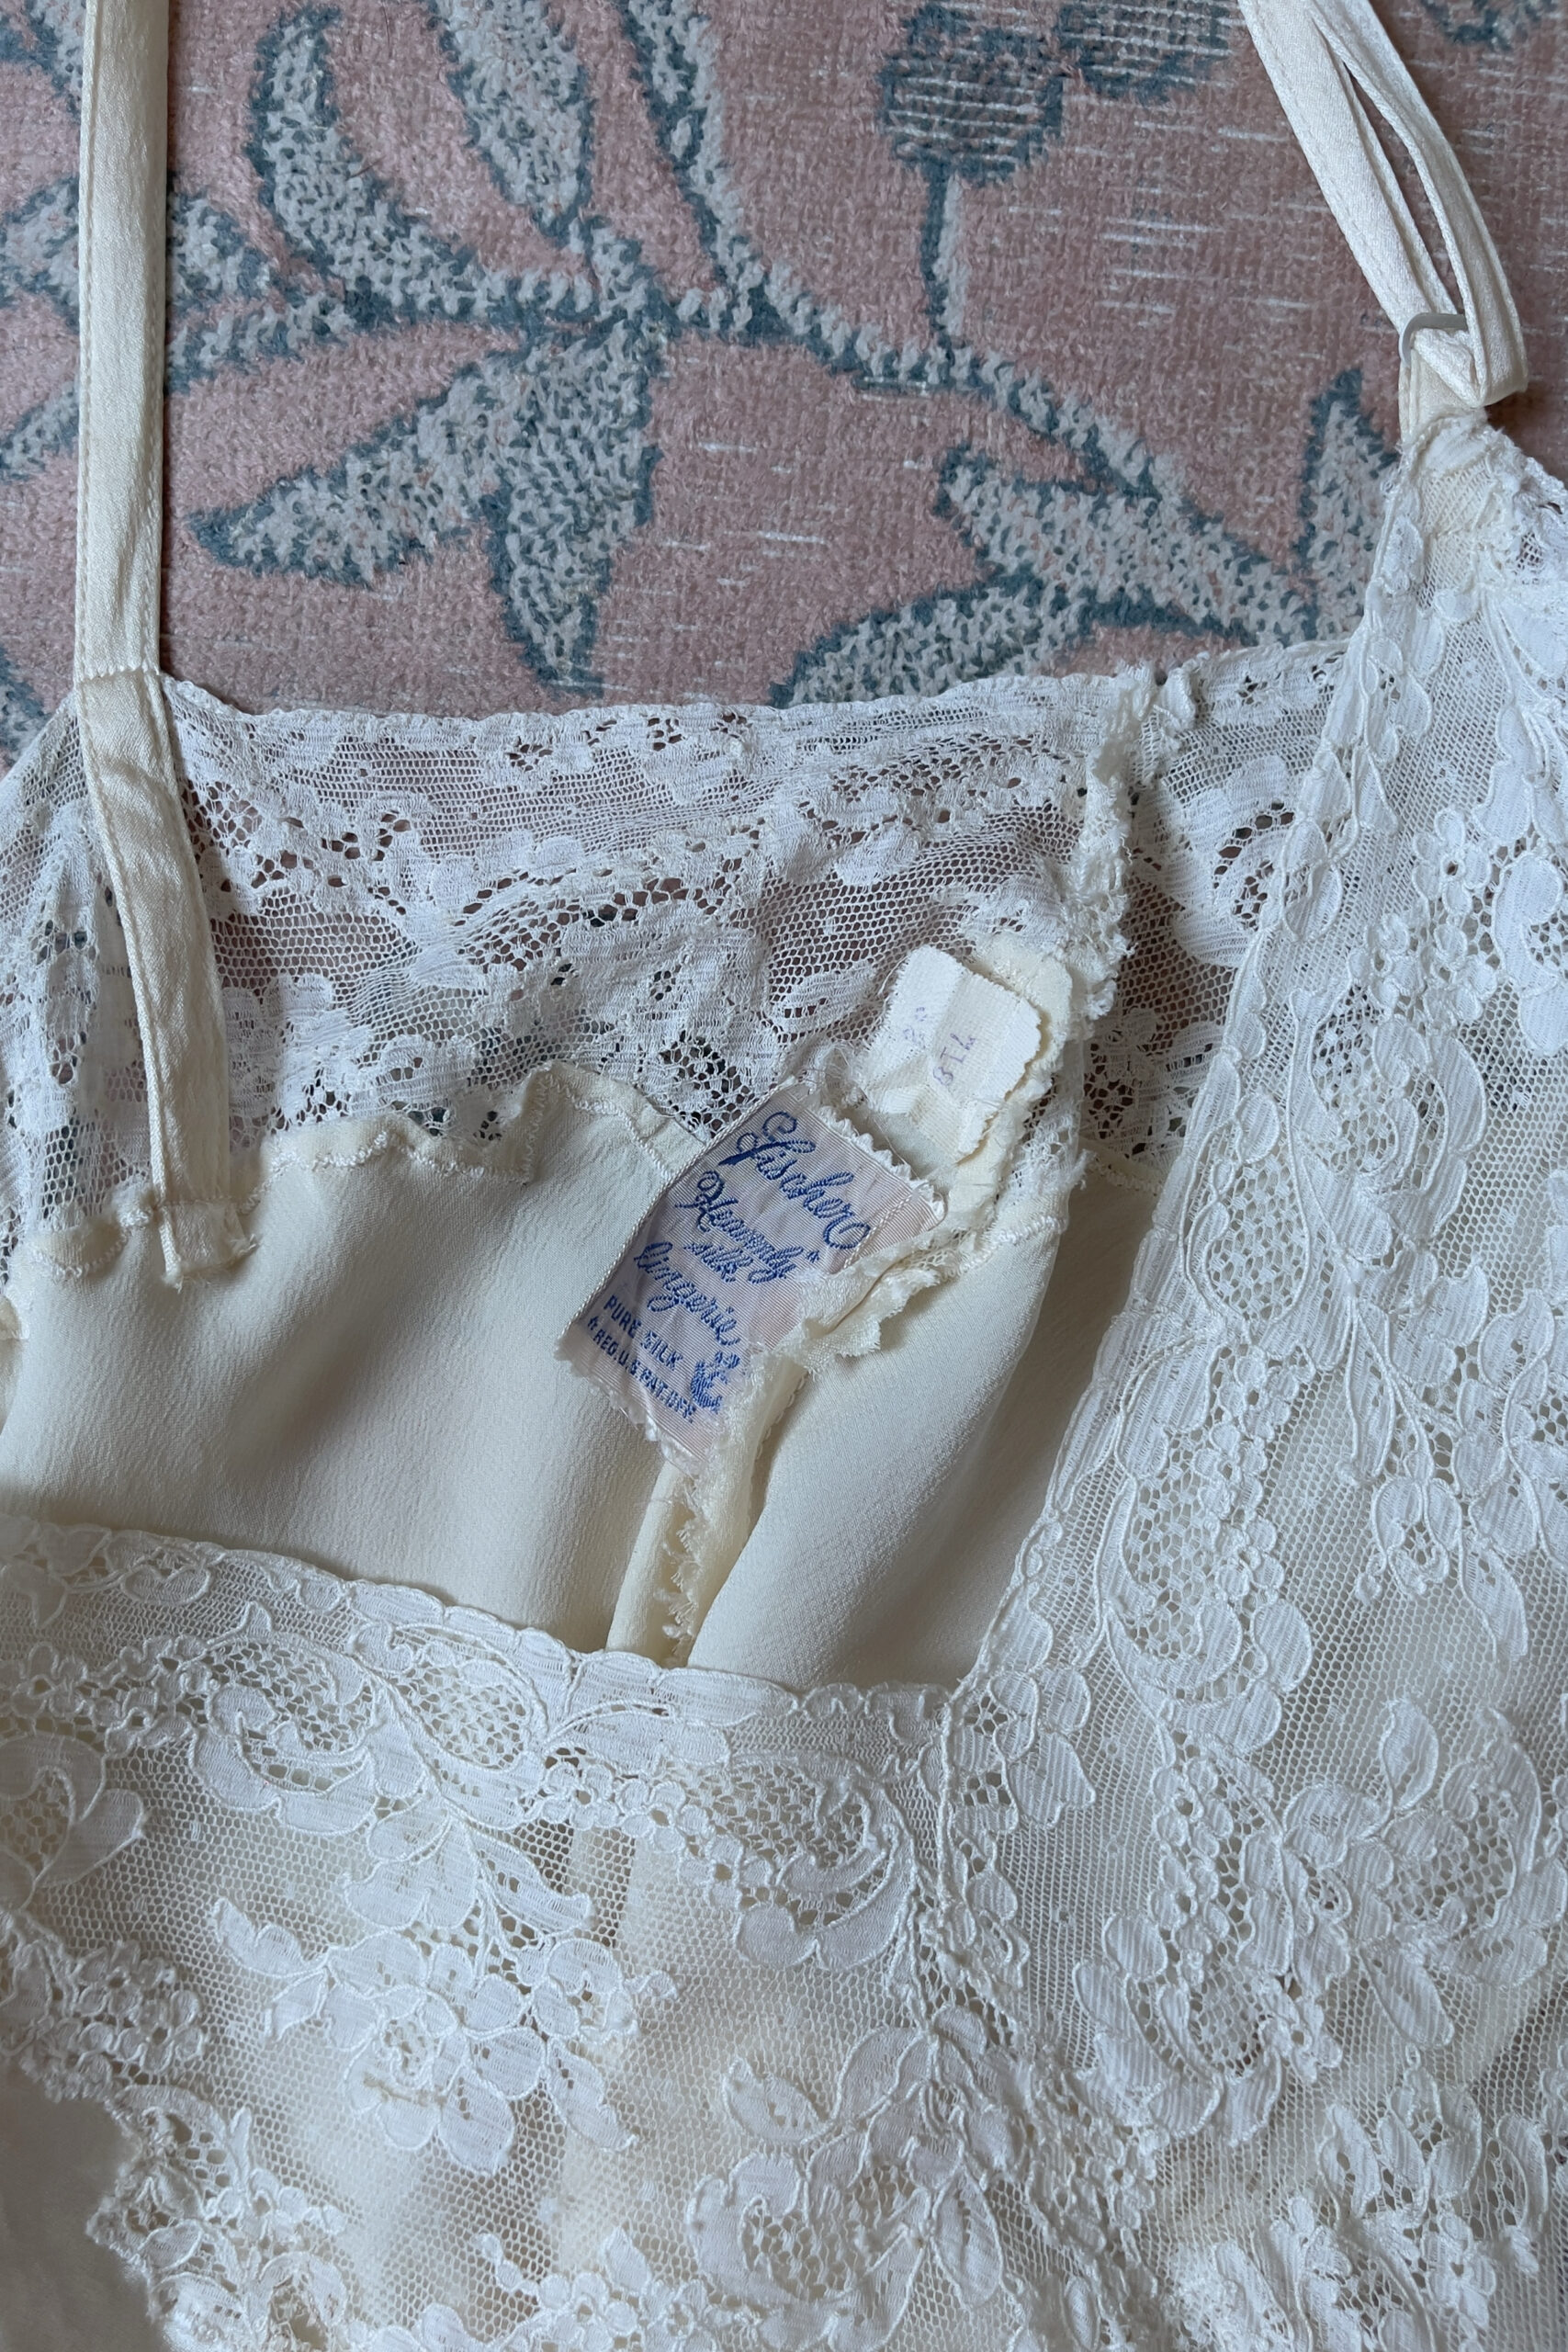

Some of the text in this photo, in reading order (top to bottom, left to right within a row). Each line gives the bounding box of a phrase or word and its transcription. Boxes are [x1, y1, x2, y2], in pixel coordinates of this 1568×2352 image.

[674, 1170, 804, 1284] Heavenly
[717, 1110, 872, 1250] Fischer
[683, 1240, 753, 1283] silk
[604, 1295, 683, 1372] PURE SILK
